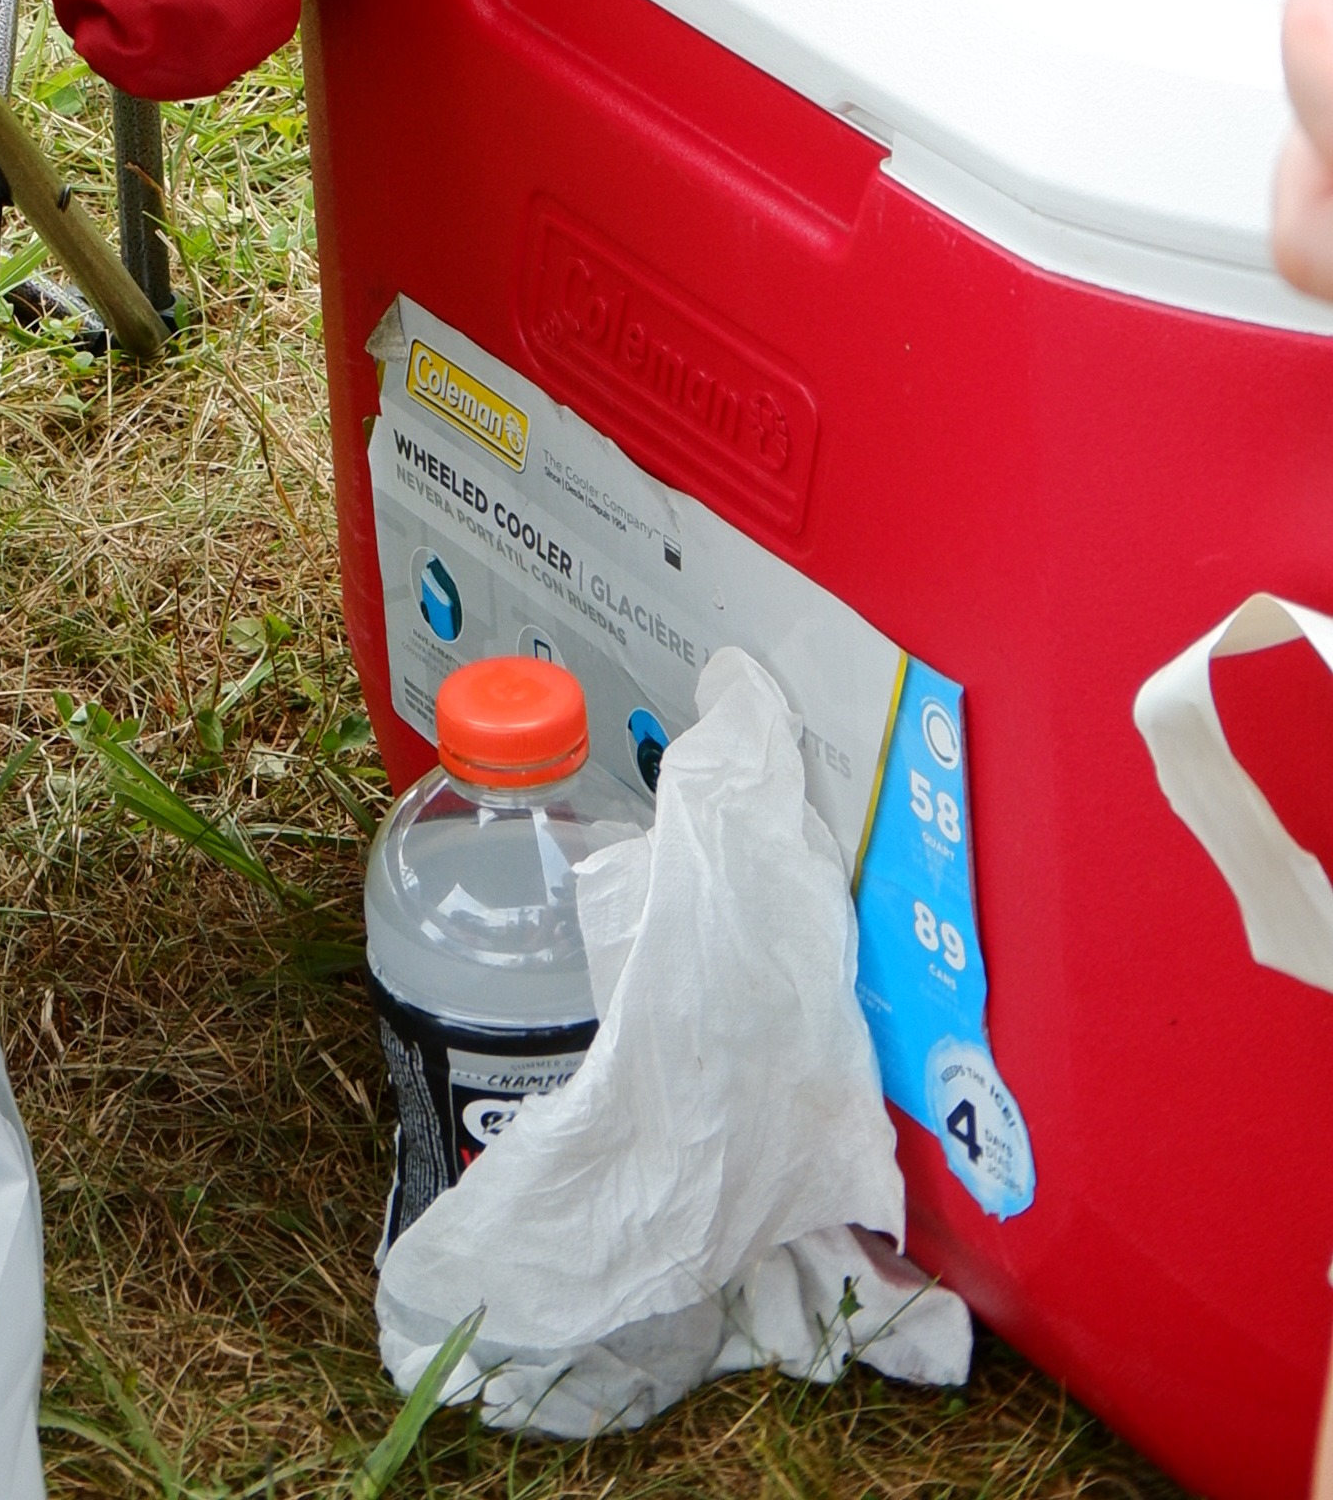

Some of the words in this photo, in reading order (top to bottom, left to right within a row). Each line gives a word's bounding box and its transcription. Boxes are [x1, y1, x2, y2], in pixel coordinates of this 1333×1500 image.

[564, 256, 741, 442] Coleman
[413, 351, 504, 439] Coleman
[542, 449, 563, 476] The
[565, 462, 600, 501] Cooler
[393, 429, 489, 514] WHEELED
[494, 502, 573, 580] COOLER
[590, 573, 697, 668] GLACIÈRE
[396, 463, 453, 520] NEVERA
[457, 506, 528, 574] PORTÁTIL
[532, 562, 564, 600] CON
[568, 587, 628, 647] RUEDAS
[909, 769, 962, 843] 58
[922, 831, 955, 861] QUART
[913, 900, 966, 971] 89
[928, 962, 958, 991] CANS
[510, 1059, 561, 1073] SUMMER
[946, 1098, 983, 1165] 4
